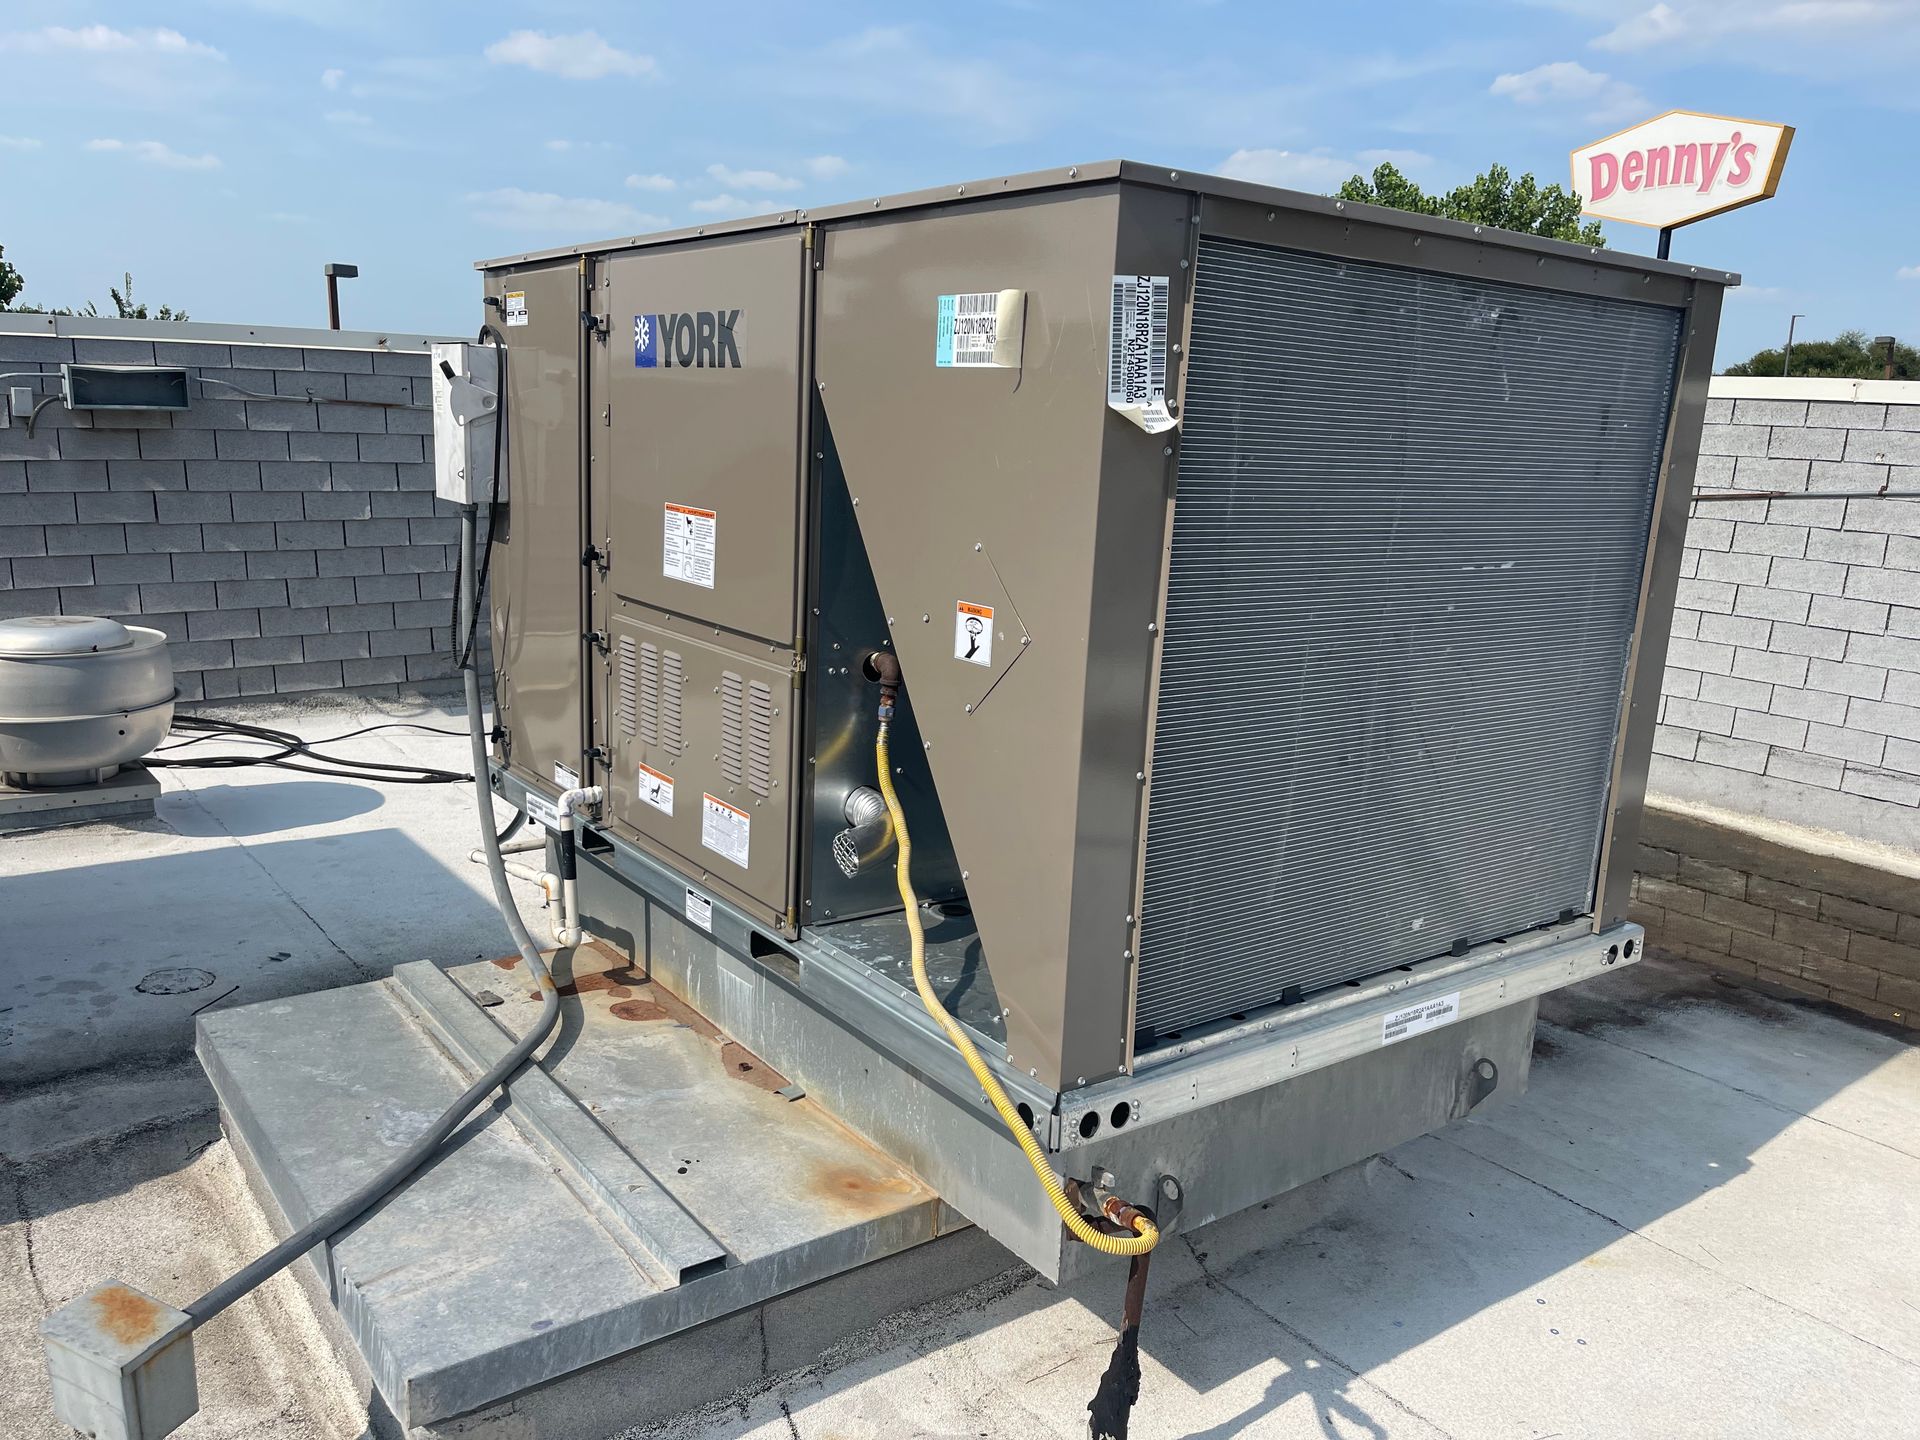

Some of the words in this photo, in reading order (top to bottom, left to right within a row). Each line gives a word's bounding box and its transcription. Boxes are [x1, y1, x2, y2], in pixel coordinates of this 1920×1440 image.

[1589, 131, 1757, 203] Denny's
[657, 309, 742, 369] YORK
[1134, 275, 1151, 399] ZJ120N18R2A1AAA1A3
[1125, 338, 1137, 404] N2F4500060
[1153, 387, 1164, 396] E
